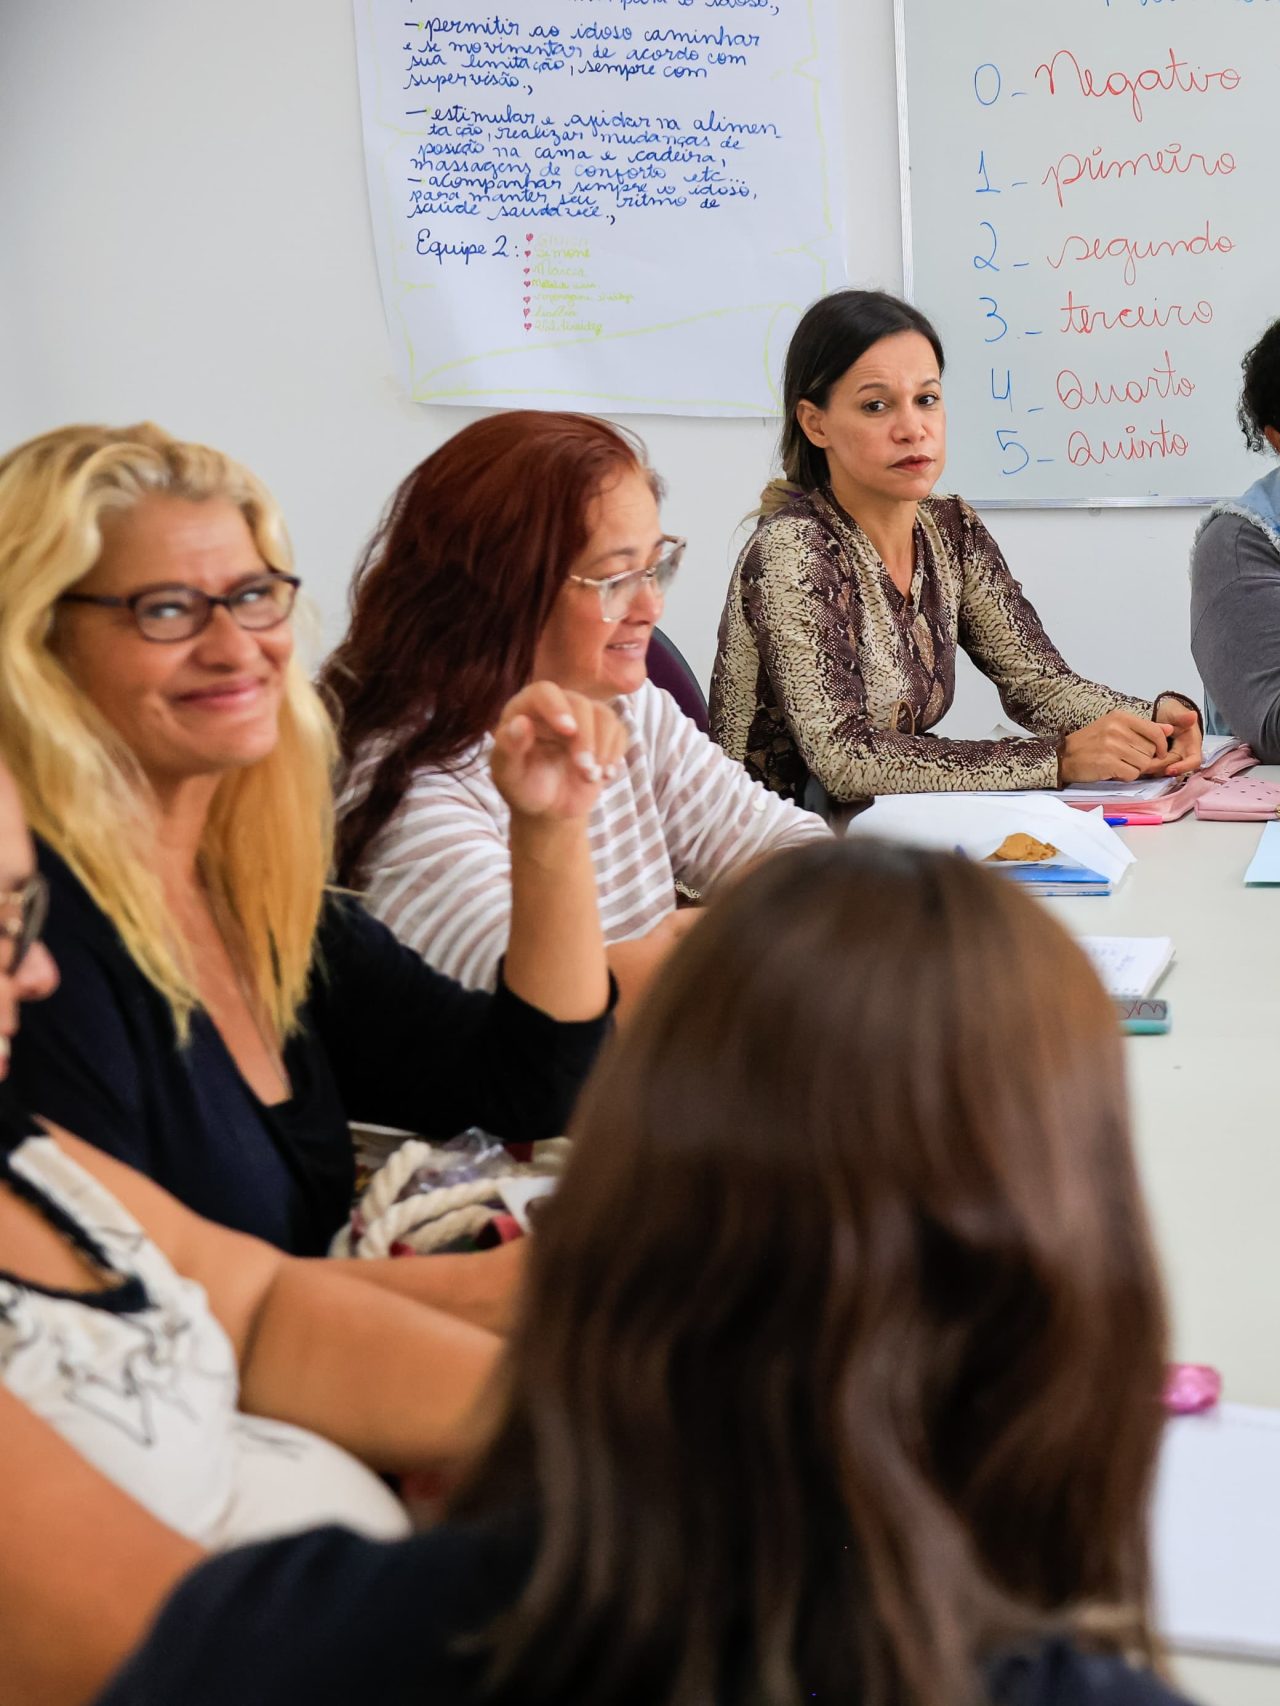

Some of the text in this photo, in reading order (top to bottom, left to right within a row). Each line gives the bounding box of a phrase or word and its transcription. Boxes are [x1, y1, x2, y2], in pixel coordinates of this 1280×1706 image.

[425, 16, 760, 47] permitir ao idoso caminhar
[402, 37, 747, 66] e se movimentar de acordo com
[405, 54, 447, 71] sua
[578, 59, 655, 81] sempre
[663, 66, 708, 79] com
[431, 104, 535, 125] estimular
[541, 116, 555, 125] e
[656, 117, 681, 131] na
[494, 125, 583, 147] realizar
[600, 130, 711, 149] mudanças
[720, 135, 745, 150] de
[418, 139, 726, 168] posição na cama e cadeira,
[410, 157, 532, 180] massagens
[540, 161, 561, 176] de
[574, 163, 667, 186] conforto
[1042, 143, 1238, 208] primeiro
[409, 187, 720, 209] para manter seu ritmo de
[570, 181, 648, 202] sempre
[407, 200, 481, 219] saúde
[416, 228, 487, 265] Equipe
[1059, 291, 1213, 334] terceiro
